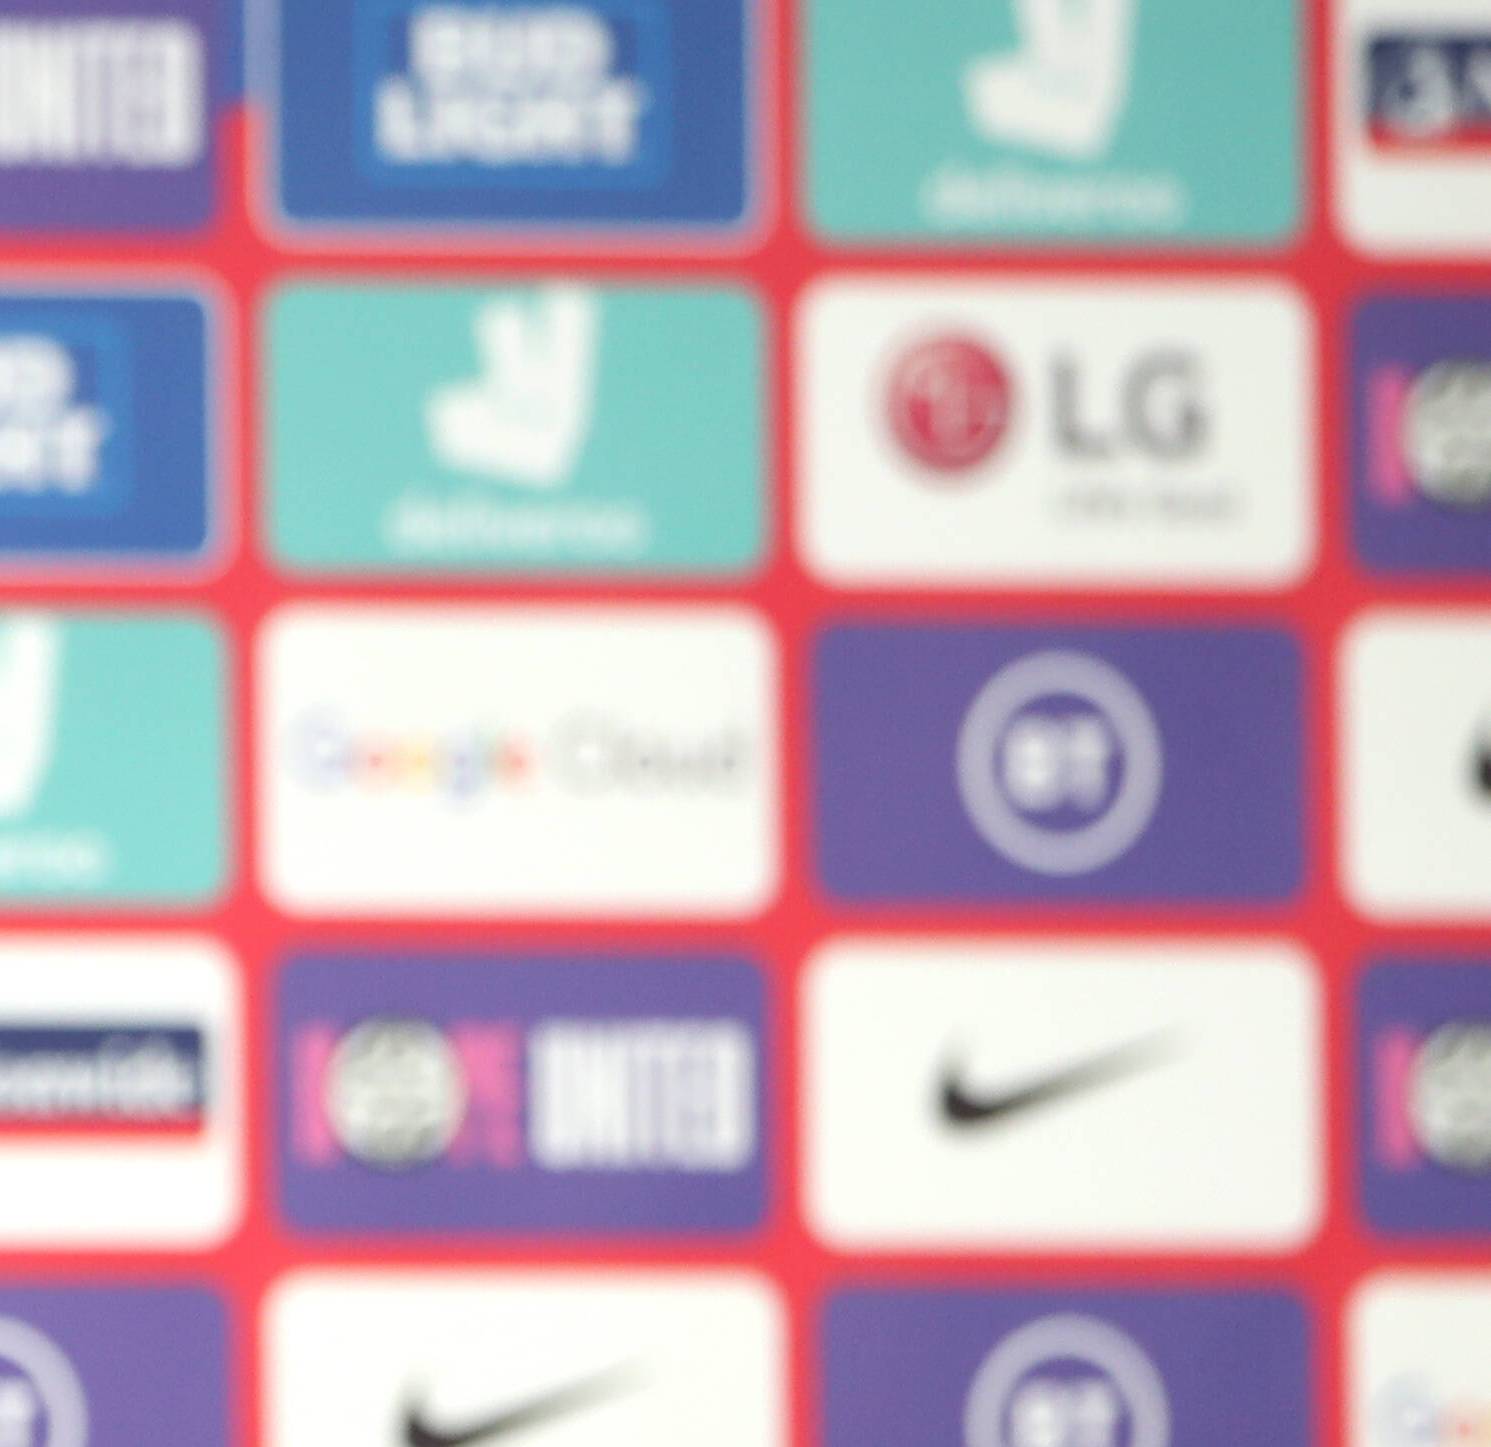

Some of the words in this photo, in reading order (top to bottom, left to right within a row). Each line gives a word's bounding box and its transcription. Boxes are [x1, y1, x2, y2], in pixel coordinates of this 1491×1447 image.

[409, 3, 612, 77] BUD
[374, 76, 646, 163] LIGHT
[1046, 345, 1215, 467] LG
[1002, 711, 1112, 812] BT
